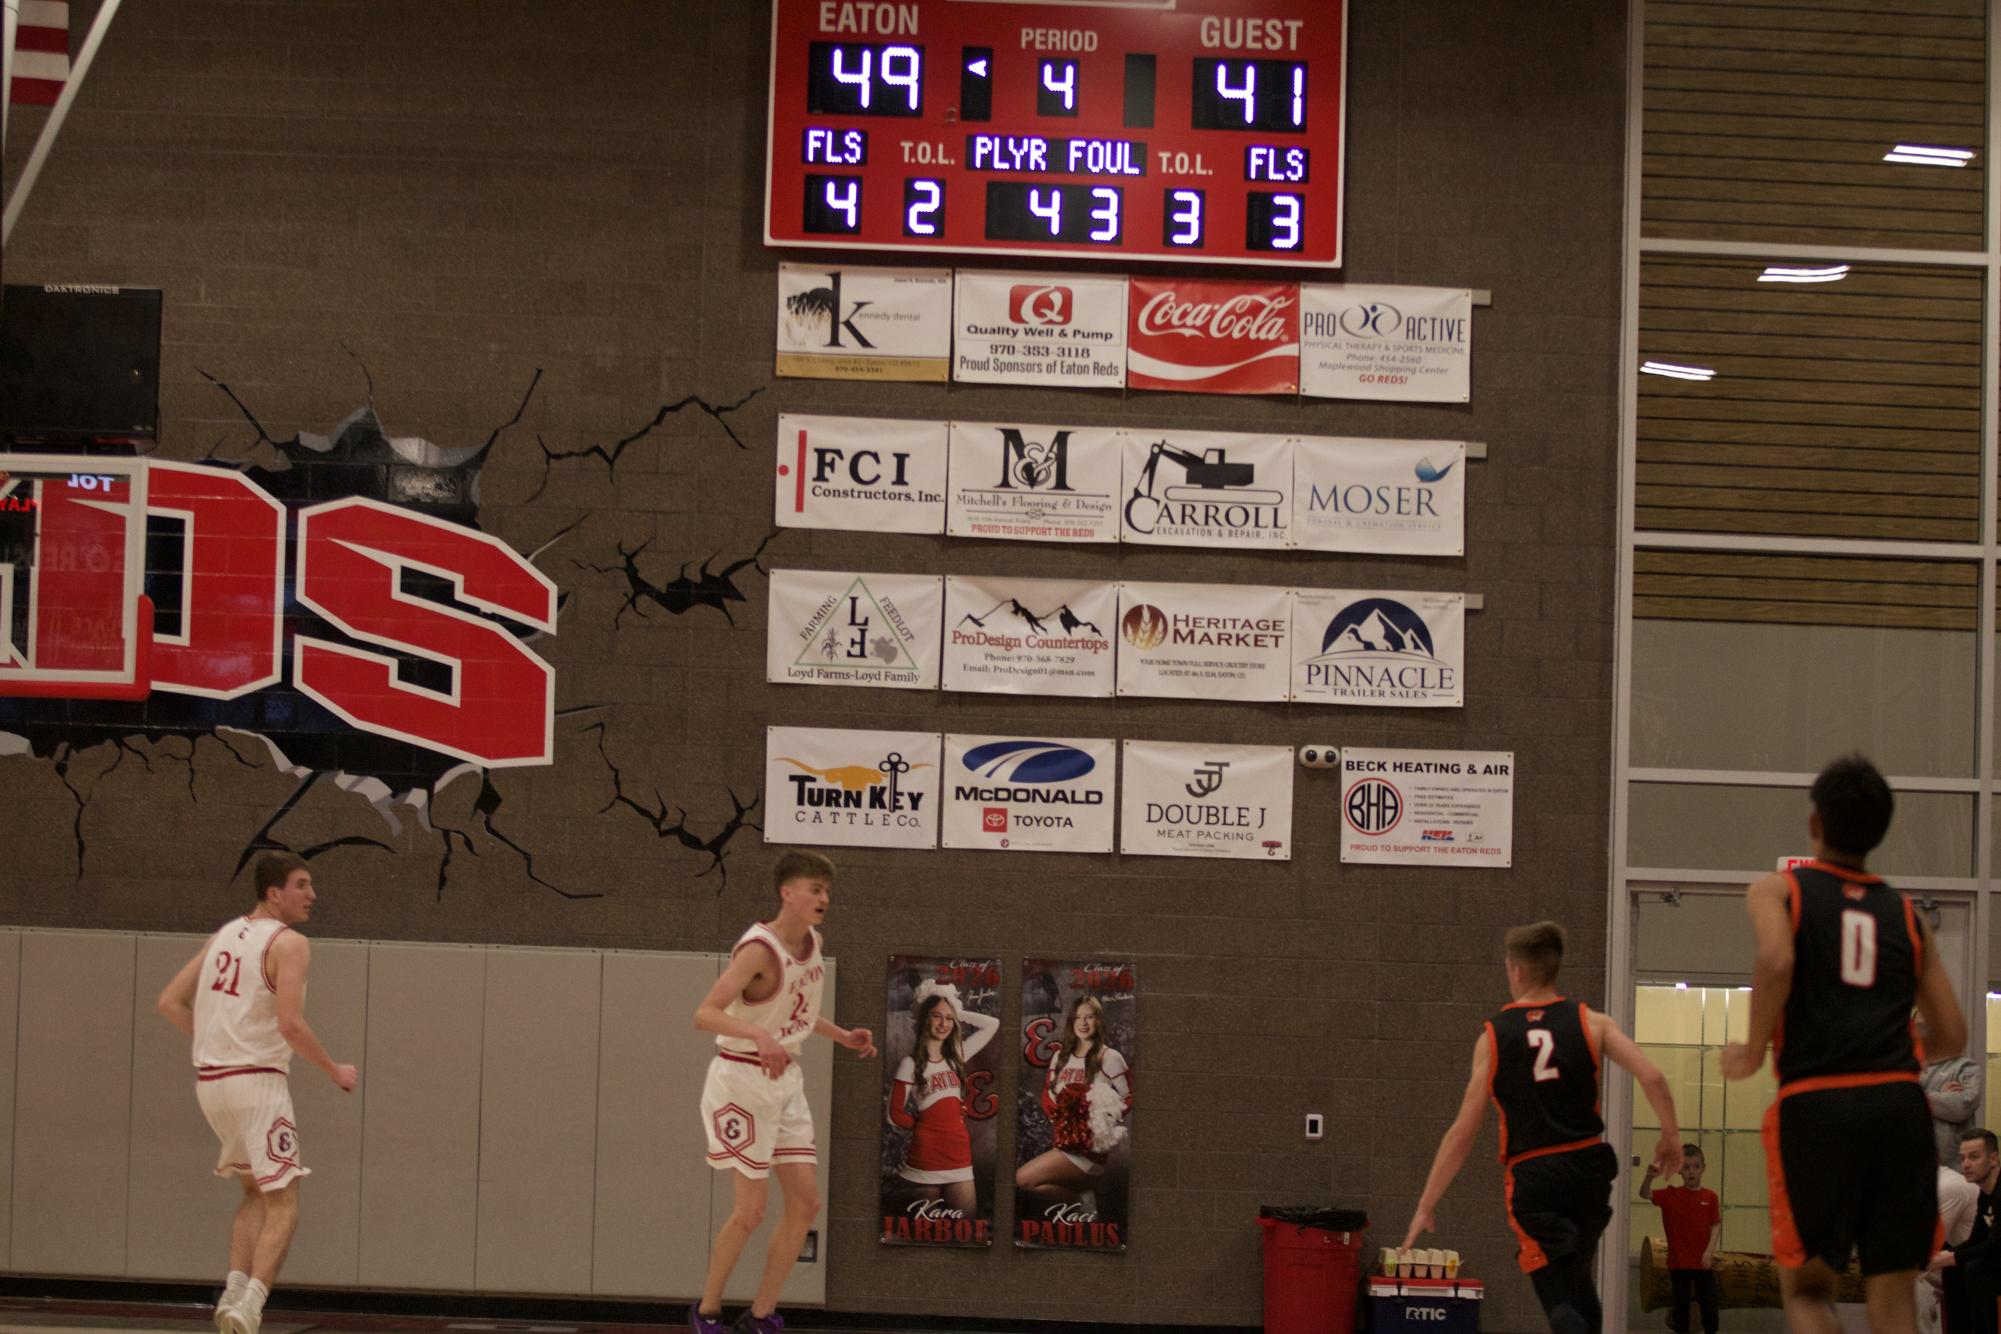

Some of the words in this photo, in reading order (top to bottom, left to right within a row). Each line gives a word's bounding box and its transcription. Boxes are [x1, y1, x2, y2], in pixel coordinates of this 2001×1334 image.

[819, 1, 919, 36] EATON
[1021, 29, 1098, 52] PERIOD
[1200, 17, 1304, 51] GUEST
[832, 46, 922, 111] 49
[1042, 63, 1074, 111] 4
[1216, 64, 1303, 125] 41
[807, 130, 862, 163] FLS
[901, 142, 955, 165] T.O.L.
[974, 135, 1047, 171] PLYR
[1068, 139, 1140, 175] FOUL
[1158, 152, 1213, 176] T.O.L.
[1249, 148, 1304, 181] FLS
[826, 182, 857, 227] 4
[909, 181, 941, 235] 2
[1029, 190, 1061, 236] 4
[1089, 188, 1119, 242] 3
[1171, 191, 1200, 244] 3
[1271, 195, 1300, 249] 3
[44, 284, 120, 295] DAKTRONICS
[1138, 291, 1296, 341] Coca-Cola
[1304, 312, 1336, 337] PRO
[1406, 316, 1467, 343] ACTIVE
[967, 324, 1019, 339] Quality
[1023, 327, 1054, 338] Well
[1058, 329, 1068, 338] &
[1073, 330, 1113, 342] Pump
[1304, 341, 1342, 350] PHYSICAL
[1345, 342, 1382, 351] THERAPY
[1394, 344, 1423, 353] SPORTS
[1426, 346, 1464, 355] MEDICINE
[960, 356, 990, 372] Proud
[993, 359, 1043, 374] Sponsors
[1046, 360, 1056, 374] of
[1060, 360, 1089, 376] Eaton
[1093, 361, 1119, 377] Reds
[1318, 361, 1371, 373] Maplewood
[1374, 363, 1416, 375] Shopping
[1419, 366, 1449, 375] Center
[1359, 375, 1375, 383] GO
[1377, 375, 1408, 385] REDS!
[812, 486, 915, 502] Constructors,
[918, 491, 944, 503] Inc.
[956, 494, 1006, 507] Mitchell's
[1012, 496, 1057, 510] Flooring
[1076, 500, 1112, 512] Design
[1309, 484, 1440, 516] MOSER
[1125, 496, 1287, 534] CARROLL
[971, 524, 1000, 534] PROUD
[1002, 525, 1013, 534] TO
[1014, 526, 1052, 536] SUPPORT
[1055, 527, 1071, 536] THE
[1072, 528, 1095, 538] REDS
[1157, 527, 1212, 537] EXCAVATION
[1269, 531, 1288, 540] INC.
[800, 595, 838, 641] FARMING
[879, 597, 915, 642] FEEDLOT
[1173, 614, 1285, 632] HERITAGE
[952, 630, 1021, 651] ProDesign
[1025, 635, 1108, 654] Countertops
[1173, 629, 1284, 648] MARKET
[963, 664, 991, 673] Email:
[984, 653, 1014, 662] Phone:
[788, 667, 813, 680] Loyd
[884, 672, 920, 683] Family
[1306, 664, 1455, 689] PINNACLE
[1333, 688, 1386, 698] TRAILER
[1390, 689, 1427, 699] SALES
[1345, 760, 1387, 772] BECK
[1393, 762, 1461, 774] HEATING
[1467, 764, 1477, 774] &
[1483, 765, 1509, 776] AIR
[789, 775, 862, 808] TURN
[869, 786, 923, 812] KEY
[796, 811, 890, 826] CATTLE
[1013, 815, 1074, 828] TOYOTA
[1146, 803, 1250, 827] DOUBLE
[1258, 807, 1267, 829] J
[1157, 829, 1192, 839] MEAT
[1197, 830, 1254, 841] PACKING
[1350, 843, 1378, 852] PROUD
[1381, 845, 1392, 853] TO
[1393, 845, 1431, 855] SUPPORT
[1432, 846, 1448, 855] THE
[1451, 846, 1478, 855] EATON
[1480, 847, 1502, 856] REDS
[1840, 908, 1877, 988] 0
[211, 951, 241, 997] 21
[1527, 1029, 1560, 1082] 2
[907, 1199, 964, 1223] Kara
[1044, 1202, 1097, 1225] Kaci
[1021, 1220, 1120, 1246] PAULUS
[1406, 1307, 1447, 1320] RTIC
